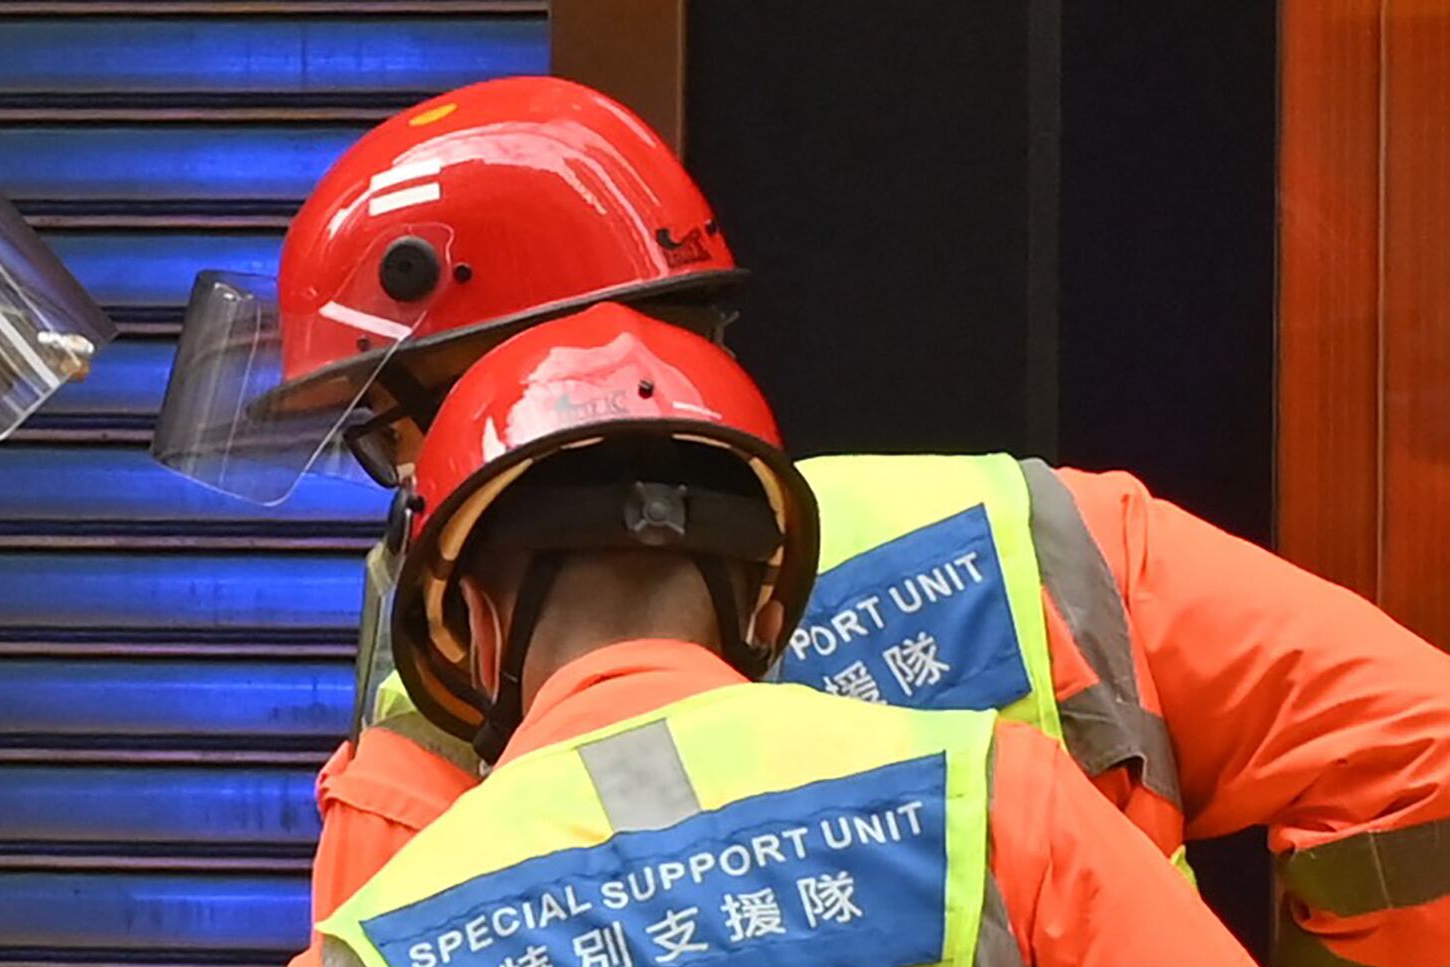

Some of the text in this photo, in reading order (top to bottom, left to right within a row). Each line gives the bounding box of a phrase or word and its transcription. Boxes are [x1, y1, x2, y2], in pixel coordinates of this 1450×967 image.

[789, 552, 983, 661] PORT UNIT
[599, 826, 810, 911] SUPPORT
[820, 800, 925, 851] UNIT
